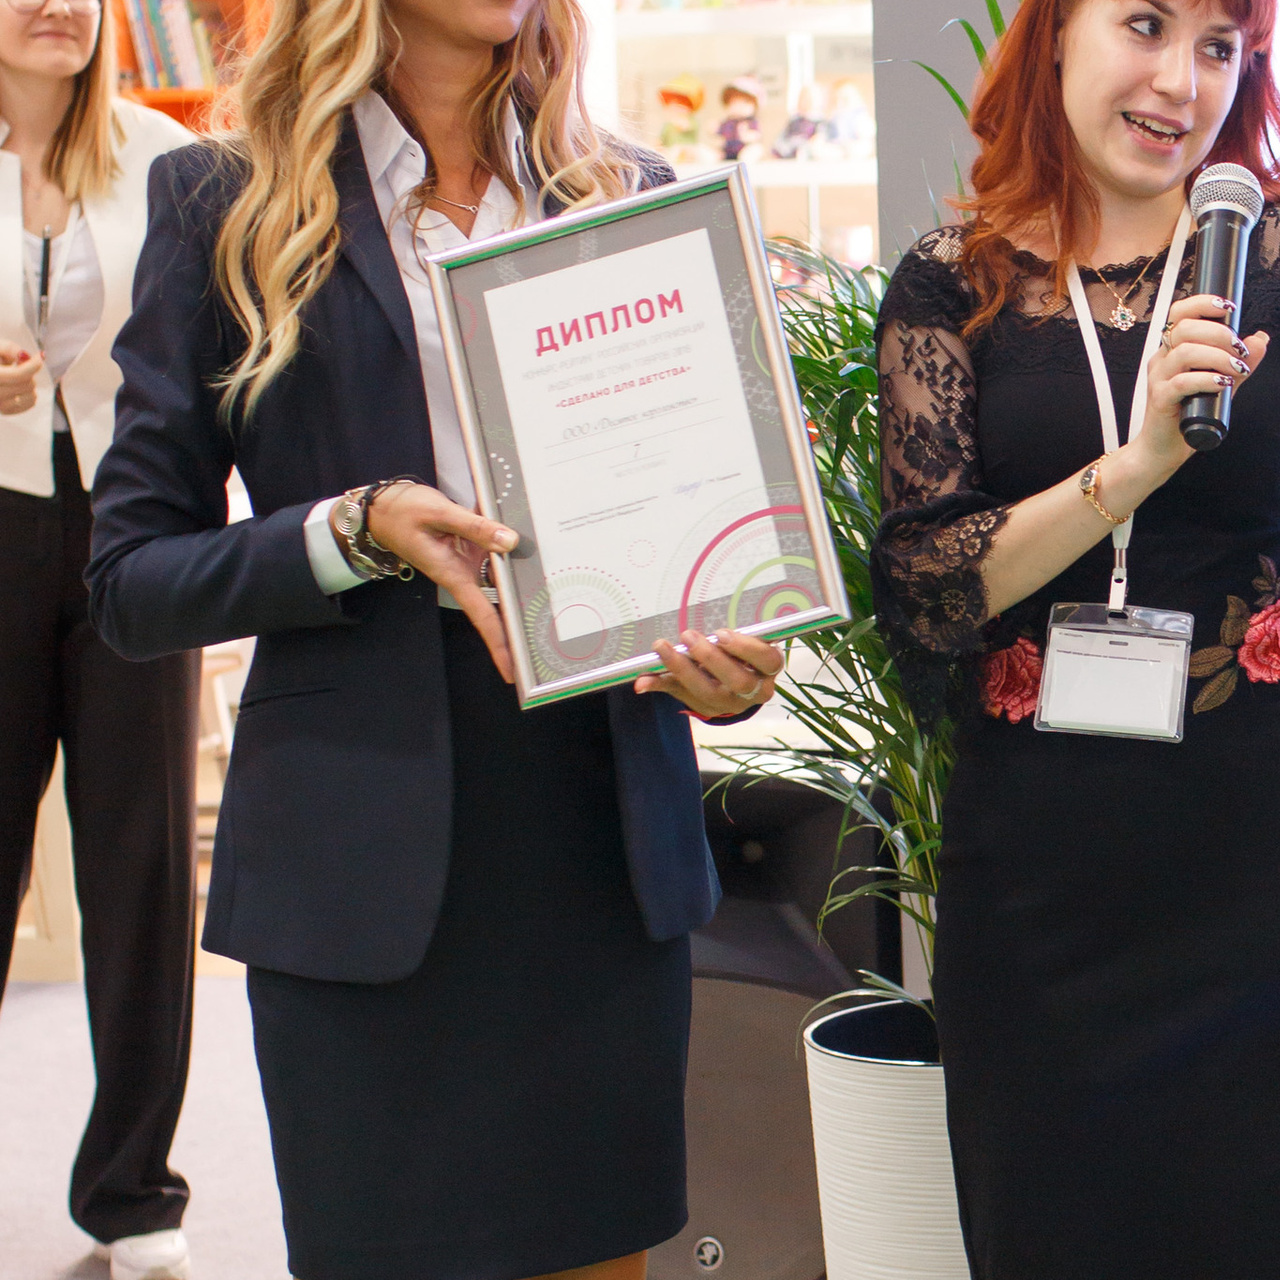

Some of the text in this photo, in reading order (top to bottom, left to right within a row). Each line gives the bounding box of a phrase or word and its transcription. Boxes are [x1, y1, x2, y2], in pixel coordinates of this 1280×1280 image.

[535, 288, 685, 358] ДИПЛОМ
[555, 365, 692, 409] «СДЕЛАНО ДЛЯ ДЕТСТВА»
